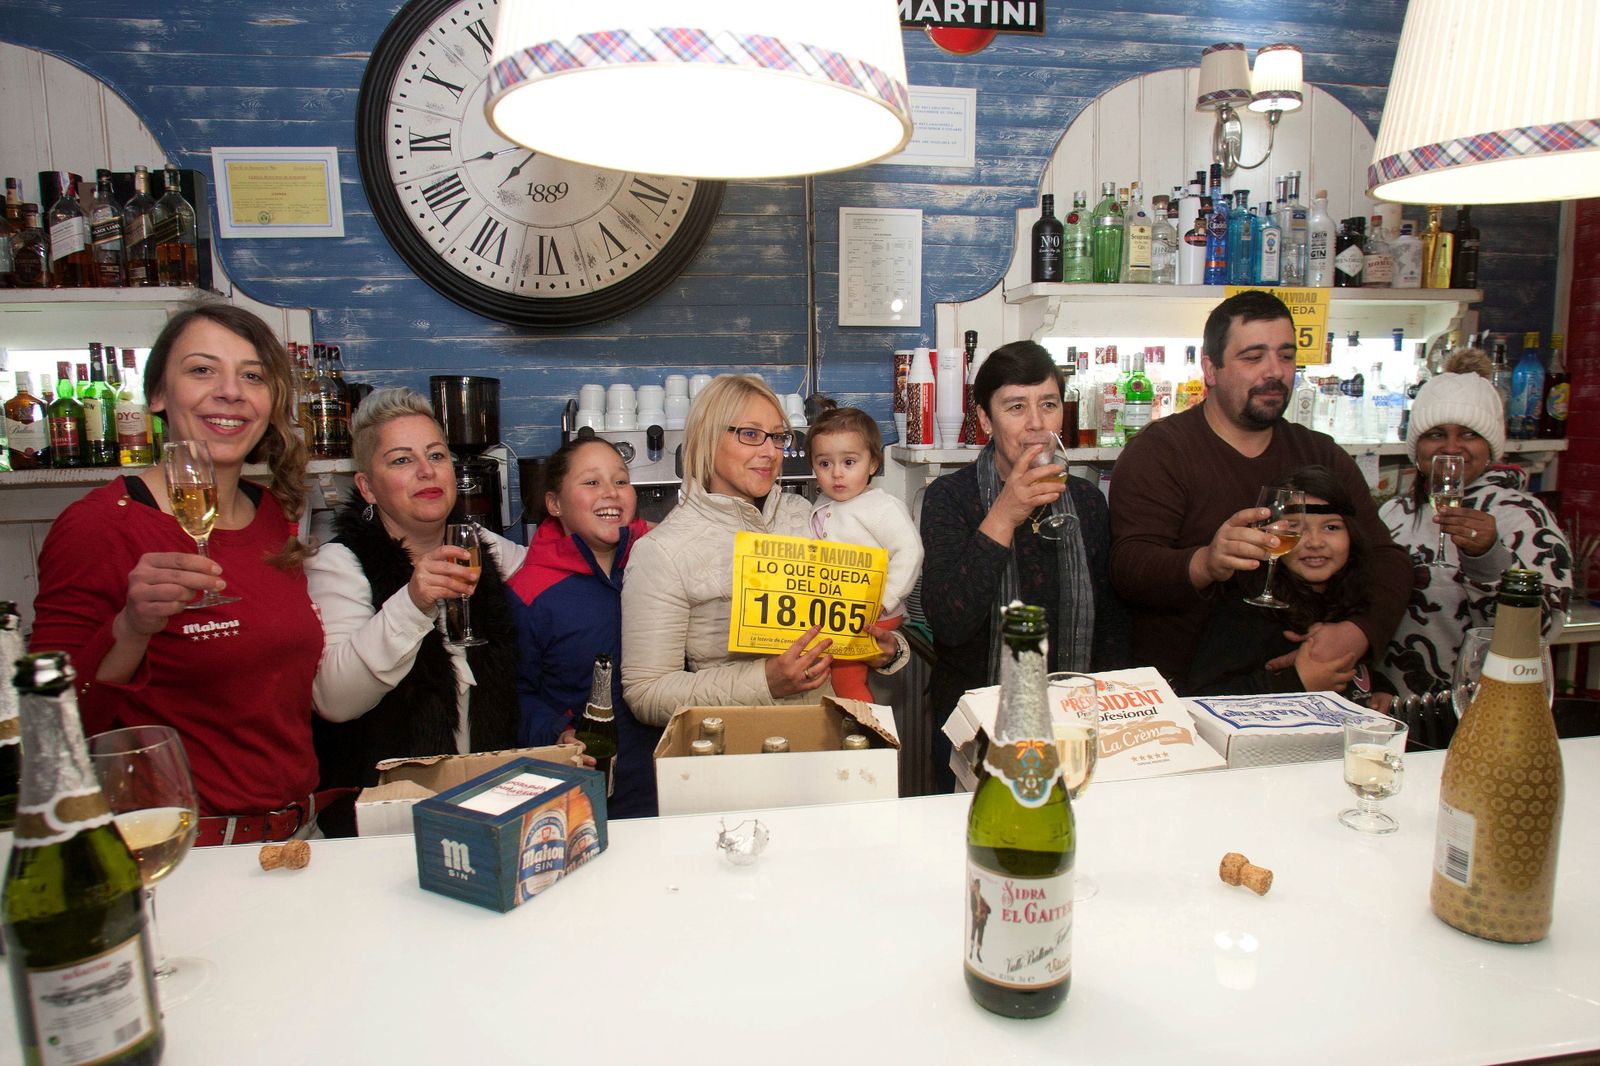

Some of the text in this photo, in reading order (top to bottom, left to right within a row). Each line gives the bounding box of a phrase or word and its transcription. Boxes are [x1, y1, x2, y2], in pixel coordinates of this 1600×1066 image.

[420, 63, 464, 103] X
[526, 182, 569, 203] 1889
[754, 540, 805, 560] LOTERIA
[820, 547, 872, 568] NAVIDAD
[757, 561, 871, 585] LO QUE QUEDA
[786, 578, 842, 596] DEL DÍA
[754, 593, 867, 634] 18.065
[182, 619, 240, 635] Mahou
[1513, 663, 1538, 677] Oro
[1101, 740, 1121, 754] La
[448, 869, 469, 881] SIN
[535, 861, 553, 873] SIN
[1002, 908, 1022, 923] EL
